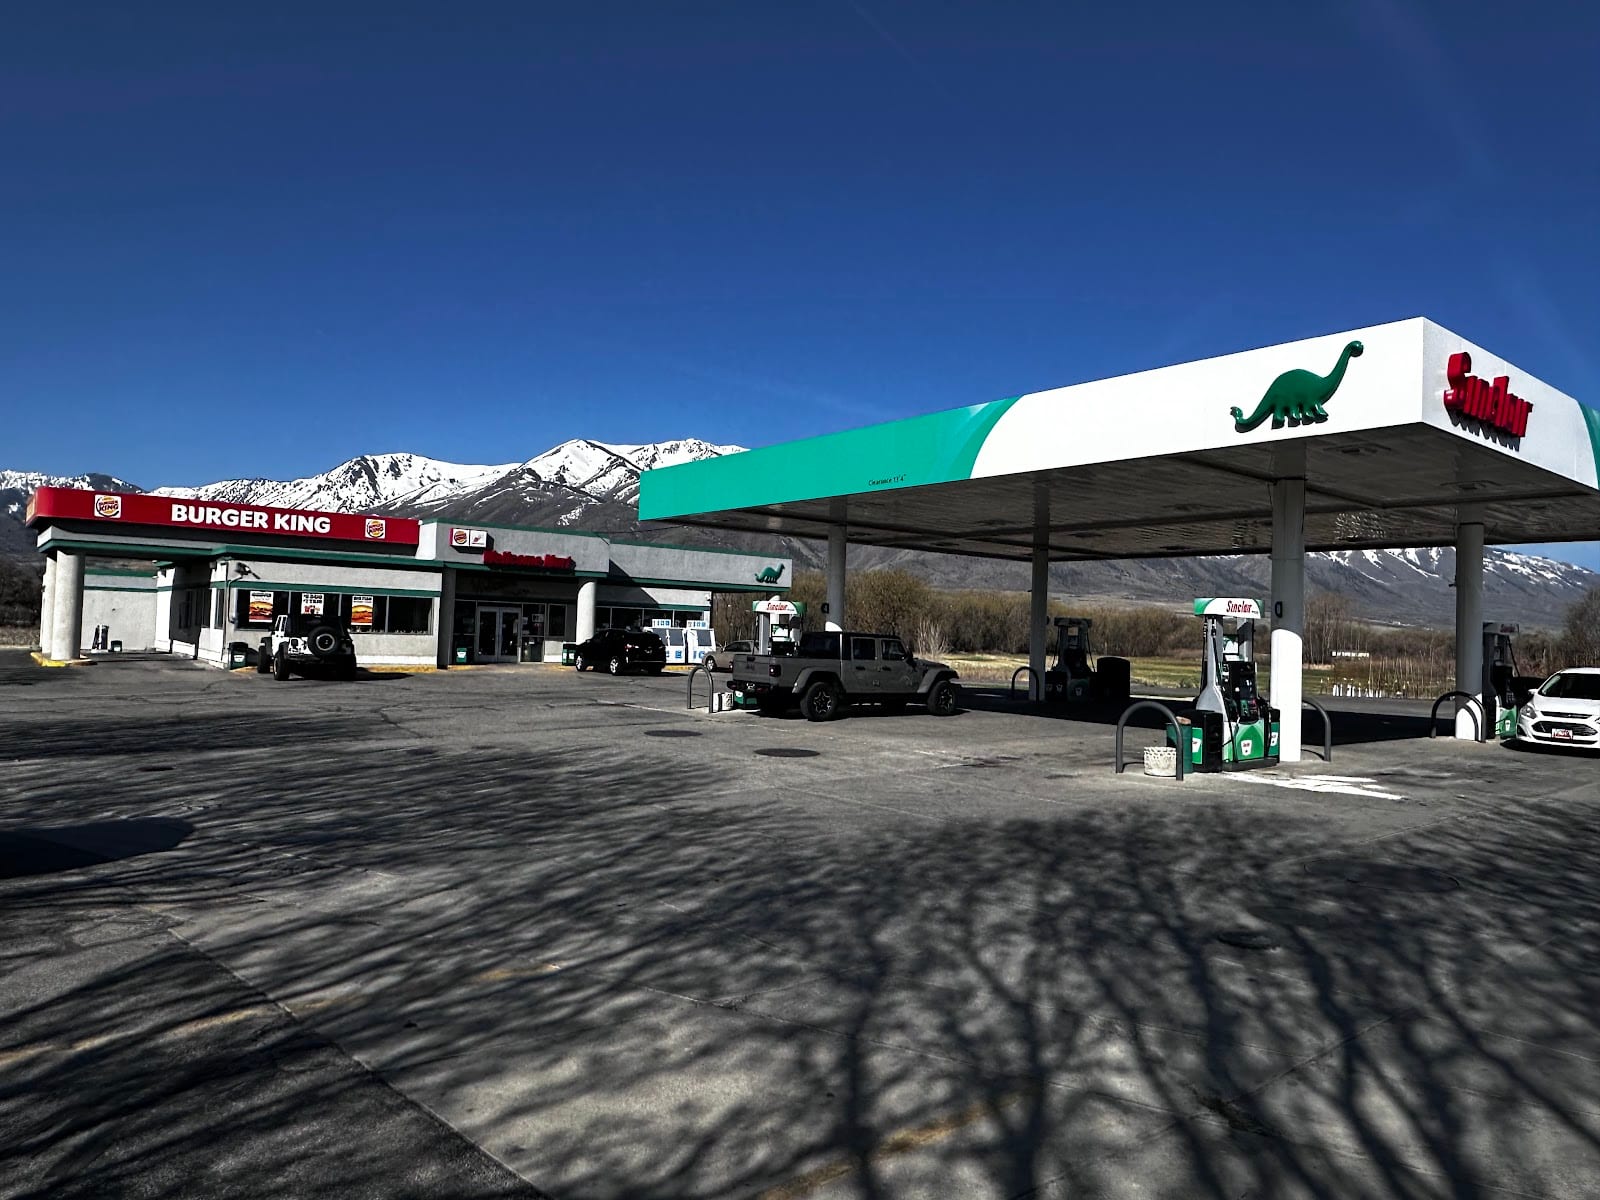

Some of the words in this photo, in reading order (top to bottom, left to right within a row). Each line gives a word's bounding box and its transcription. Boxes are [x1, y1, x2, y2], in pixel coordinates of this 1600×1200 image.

[171, 503, 269, 529] BURGER
[274, 513, 331, 534] KING
[1226, 600, 1253, 613] Sinclair
